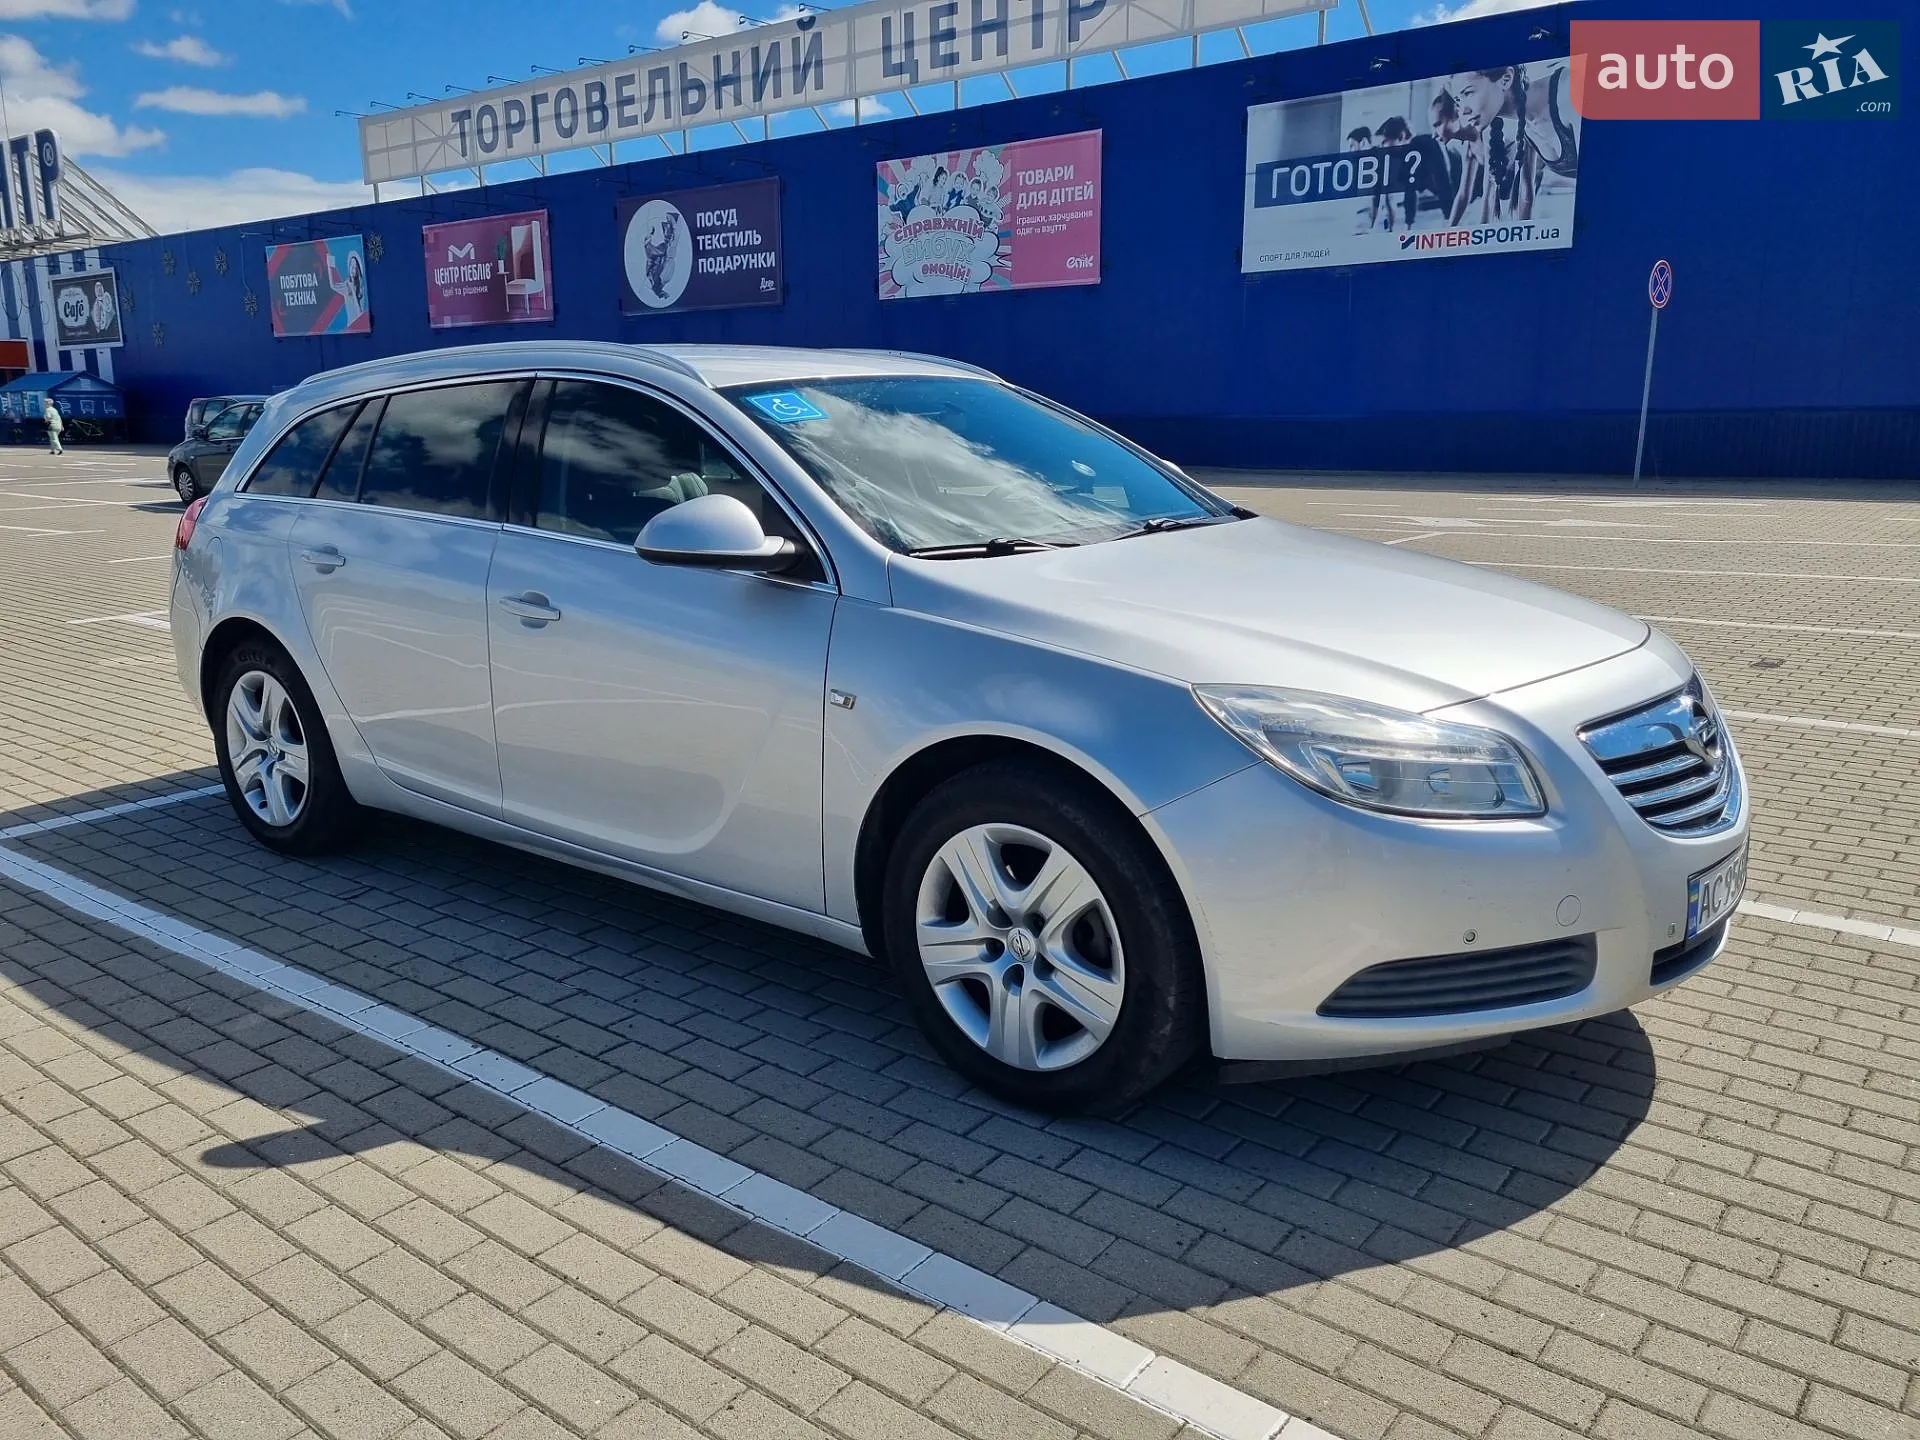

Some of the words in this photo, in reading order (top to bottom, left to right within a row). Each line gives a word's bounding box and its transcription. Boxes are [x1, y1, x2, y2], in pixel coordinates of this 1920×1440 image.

[451, 15, 824, 157] ТОРГОВЕЛЬНИЙ
[881, 0, 1106, 84] ЦЕНТР
[1016, 165, 1075, 187] ТОВАРИ
[1272, 154, 1390, 199] ГОТОВІ
[1404, 150, 1422, 184] ?
[1016, 190, 1047, 211] ДЛЯ
[1049, 181, 1094, 207] ДІТЕЙ
[697, 208, 738, 229] ПОСУД
[1048, 210, 1093, 222] харчування
[1042, 224, 1067, 235] взуття
[1416, 225, 1559, 250] INTERSPORT.ua
[697, 230, 762, 251] ТЕКСТИЛЬ
[698, 251, 777, 275] ПОДАРУНКИ
[1259, 253, 1283, 263] СПОРТ
[1284, 251, 1301, 261] ДЛЯ
[1301, 247, 1330, 260] ЛЮДЕЙ
[280, 272, 319, 290] ПОБУТОВА
[434, 266, 460, 287] ЦЕНТР
[460, 262, 491, 283] МЕБЛІВ
[284, 289, 318, 307] ТЕХНІКА
